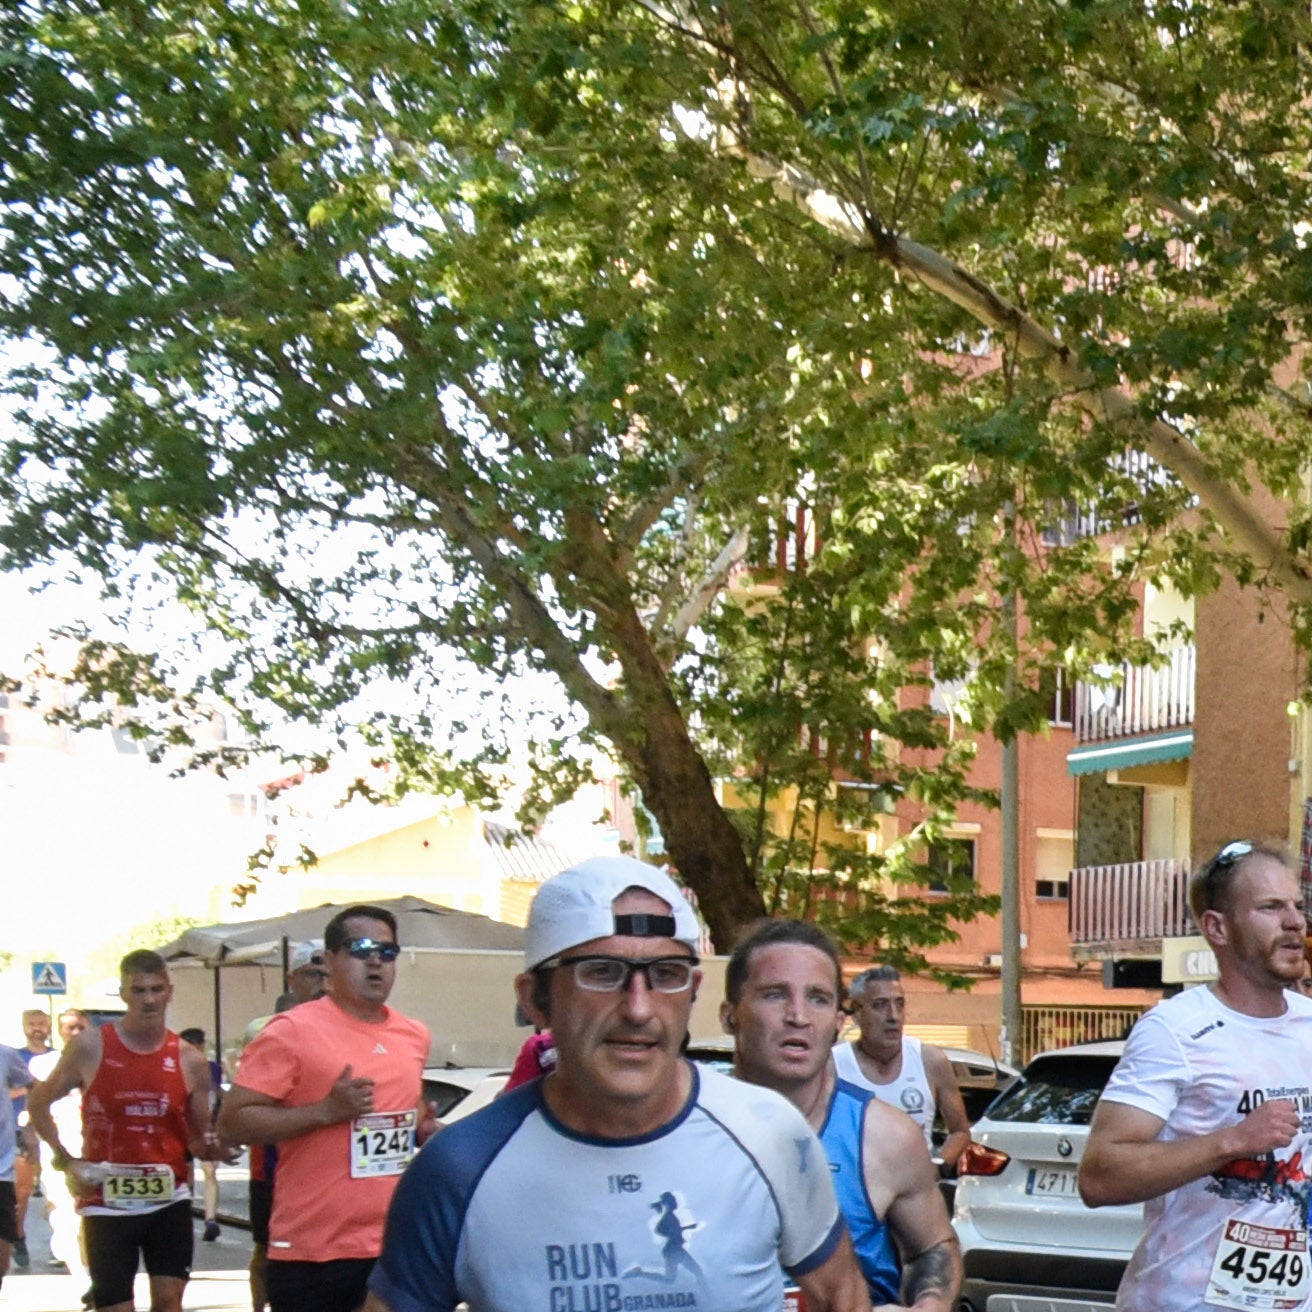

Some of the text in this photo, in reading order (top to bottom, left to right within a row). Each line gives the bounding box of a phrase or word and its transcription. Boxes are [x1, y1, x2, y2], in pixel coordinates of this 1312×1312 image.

[356, 1130, 410, 1157] 1242
[107, 1178, 164, 1195] 1533
[1229, 1223, 1251, 1243] 40
[546, 1242, 618, 1281] RUN
[1221, 1247, 1304, 1287] 4549
[623, 1292, 697, 1312] GRANADA
